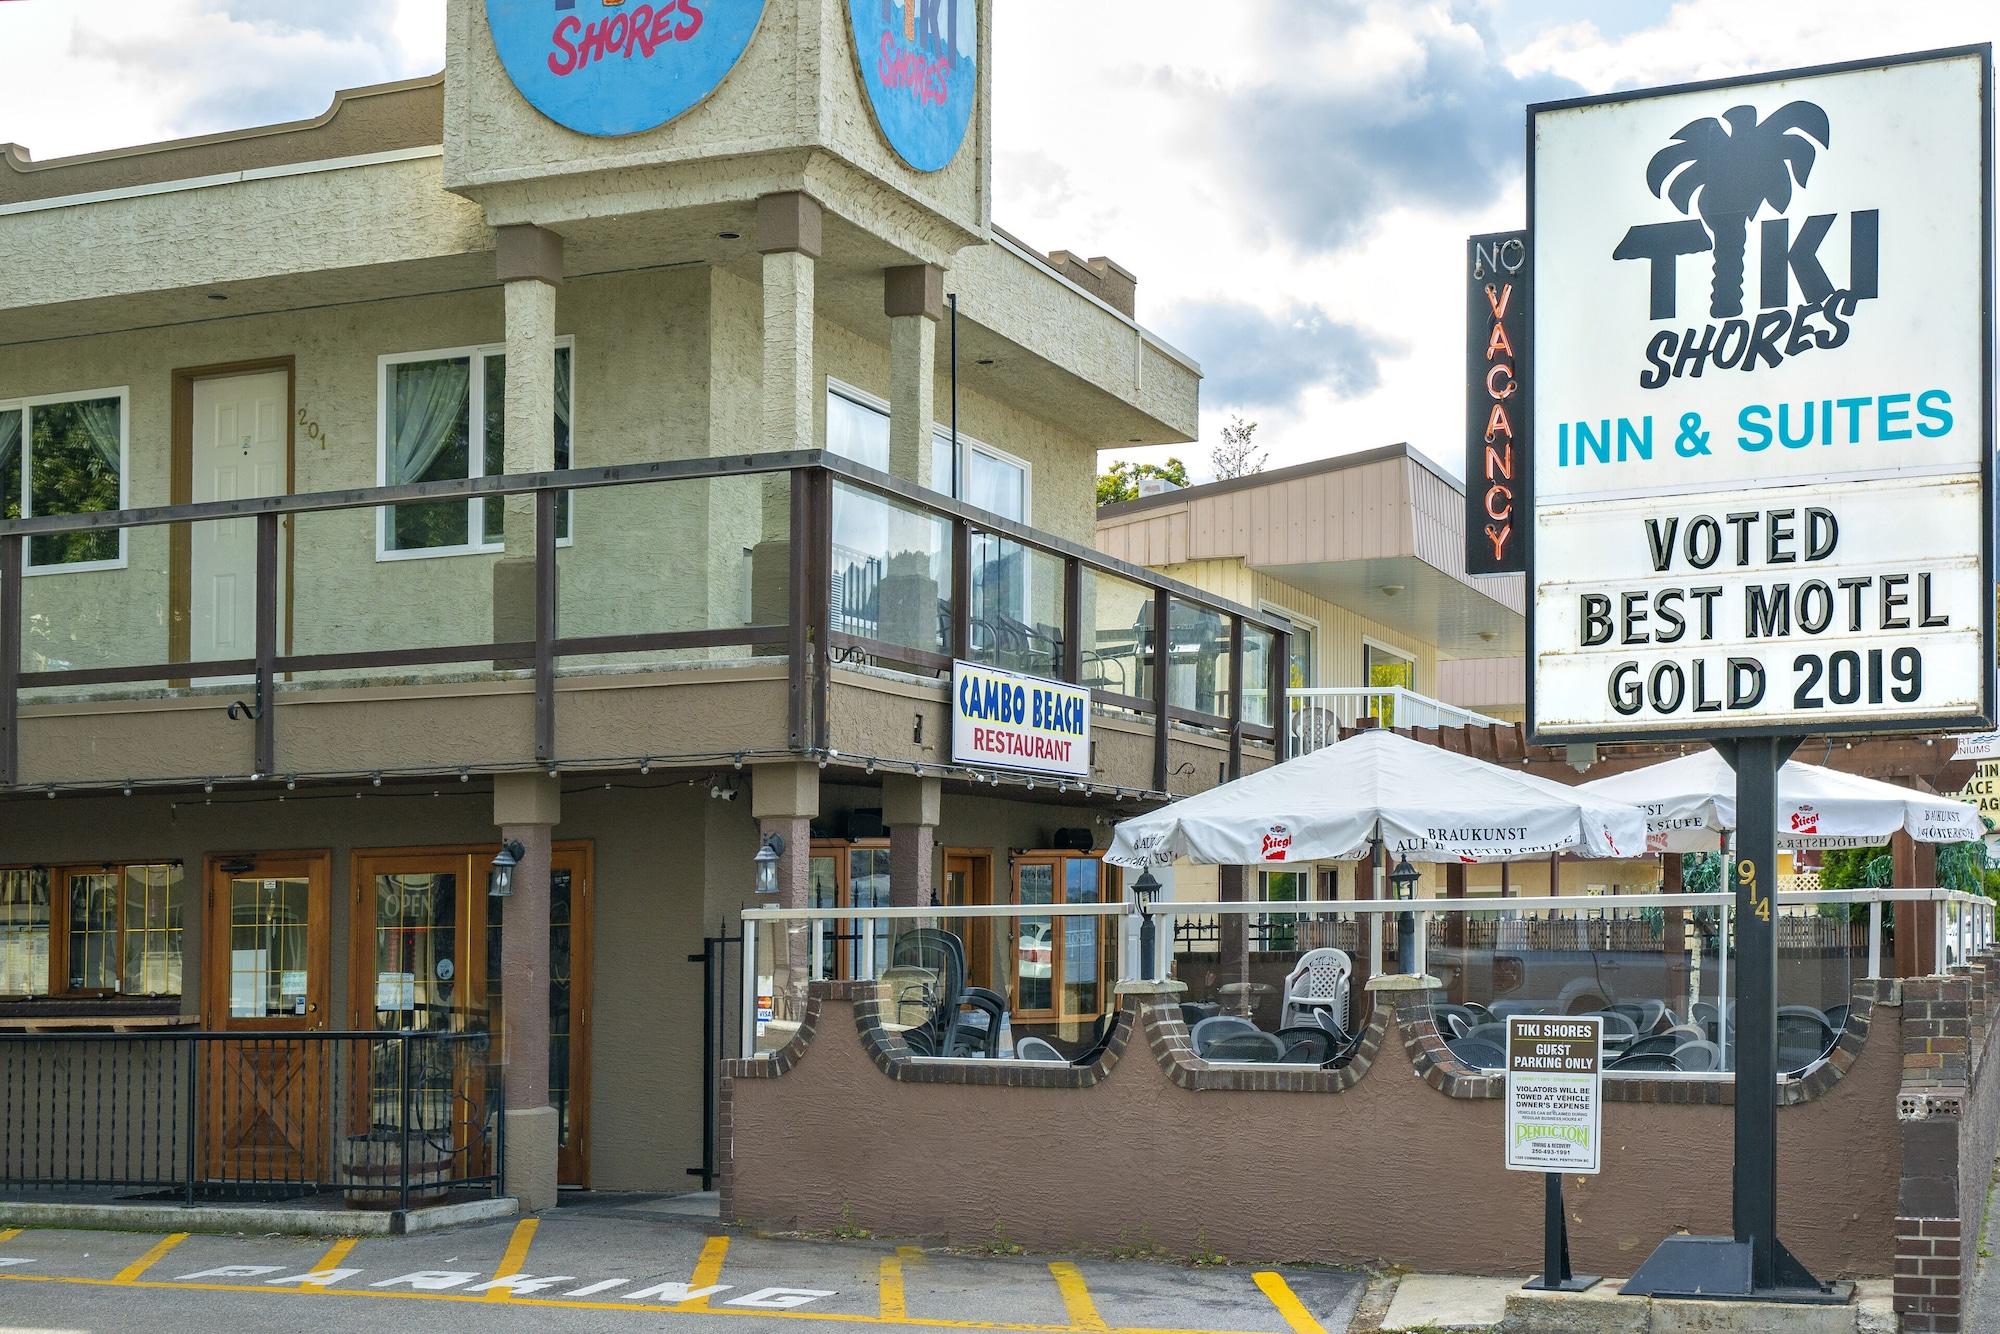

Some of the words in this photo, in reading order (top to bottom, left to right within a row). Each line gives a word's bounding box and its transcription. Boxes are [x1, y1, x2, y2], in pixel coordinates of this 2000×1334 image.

[548, 0, 703, 76] SHORES
[878, 30, 949, 105] SHORES
[1474, 240, 1525, 278] NO
[1613, 209, 1879, 320] TIKI
[1640, 289, 1857, 389] SHORES
[298, 408, 325, 450] 201
[1485, 283, 1516, 560] VACANCY
[1559, 415, 1653, 467] INN
[1674, 411, 1712, 457] &
[1737, 389, 1953, 452] SUITES
[1644, 507, 1838, 571] VOTED
[1581, 585, 1722, 647] BEST
[1745, 572, 1949, 639] MOTEL
[1607, 656, 1766, 715] GOLD
[1793, 646, 1922, 709] 2019
[960, 675, 1025, 725] CAMBO
[1033, 689, 1083, 735] BEACH
[974, 728, 1071, 762] RESTAURANT
[1427, 827, 1527, 841] BRAUKUNST
[1657, 817, 1703, 830] STUFE
[1791, 813, 1819, 830] Stiegl
[1261, 834, 1291, 855] Stiegl
[385, 893, 434, 917] OPEN
[1738, 860, 1770, 921] 914
[1516, 1024, 1540, 1036] TIKI
[1543, 1024, 1592, 1038] SHORES
[1536, 1044, 1571, 1055] GUEST
[1514, 1056, 1561, 1068] PARKING
[1565, 1057, 1593, 1069] ONLY
[1553, 1102, 1590, 1110] EXPENSE
[1515, 1123, 1589, 1150] PENTICTON
[175, 1265, 839, 1309] PARKING
